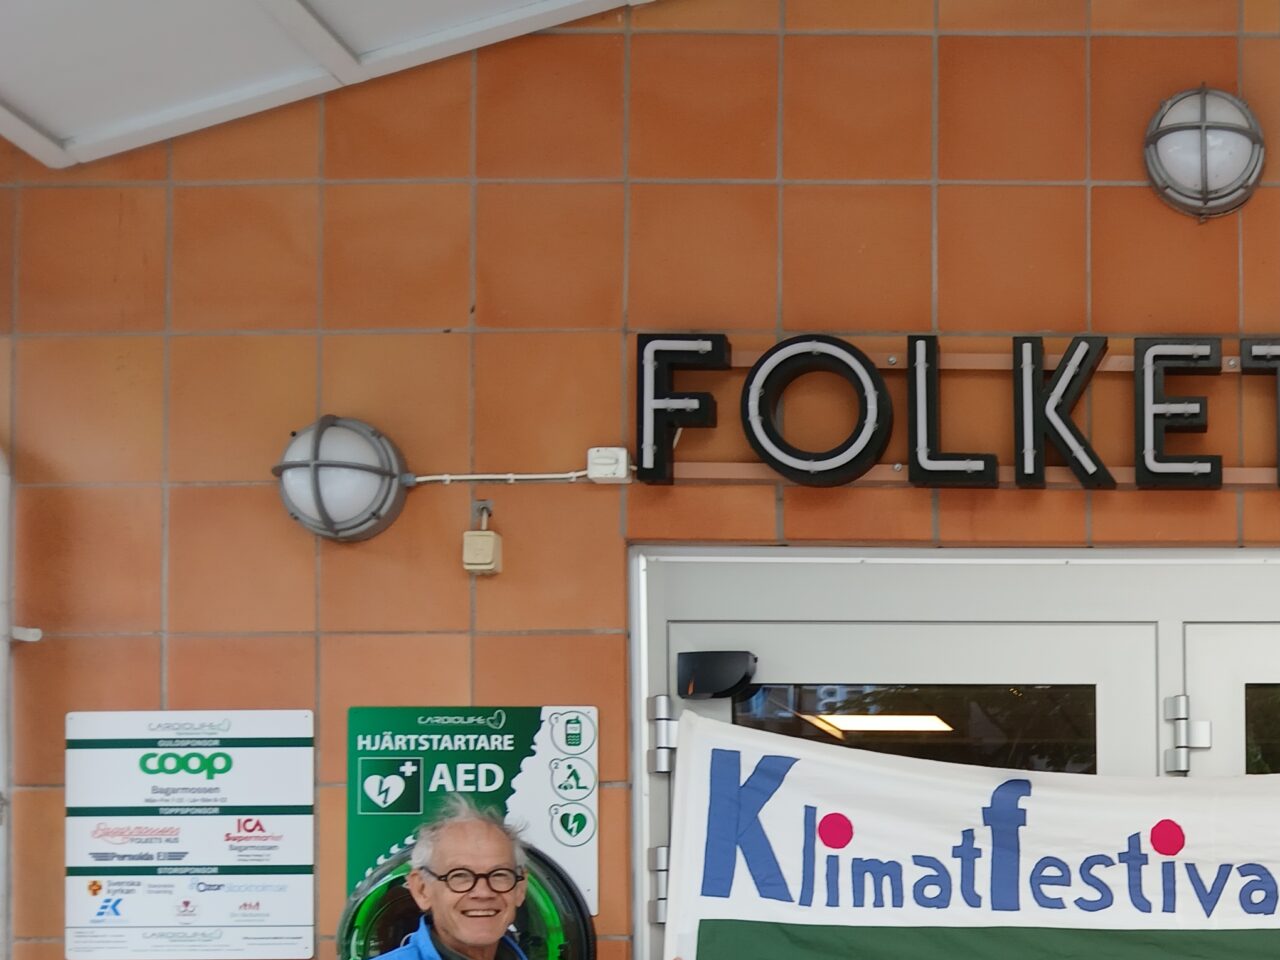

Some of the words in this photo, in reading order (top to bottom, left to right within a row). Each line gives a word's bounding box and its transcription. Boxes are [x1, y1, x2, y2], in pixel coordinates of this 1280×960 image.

[357, 731, 515, 751] HJÄRTSTARTARE
[139, 751, 234, 780] coop
[428, 763, 505, 792] AED
[236, 818, 266, 833] ICA
